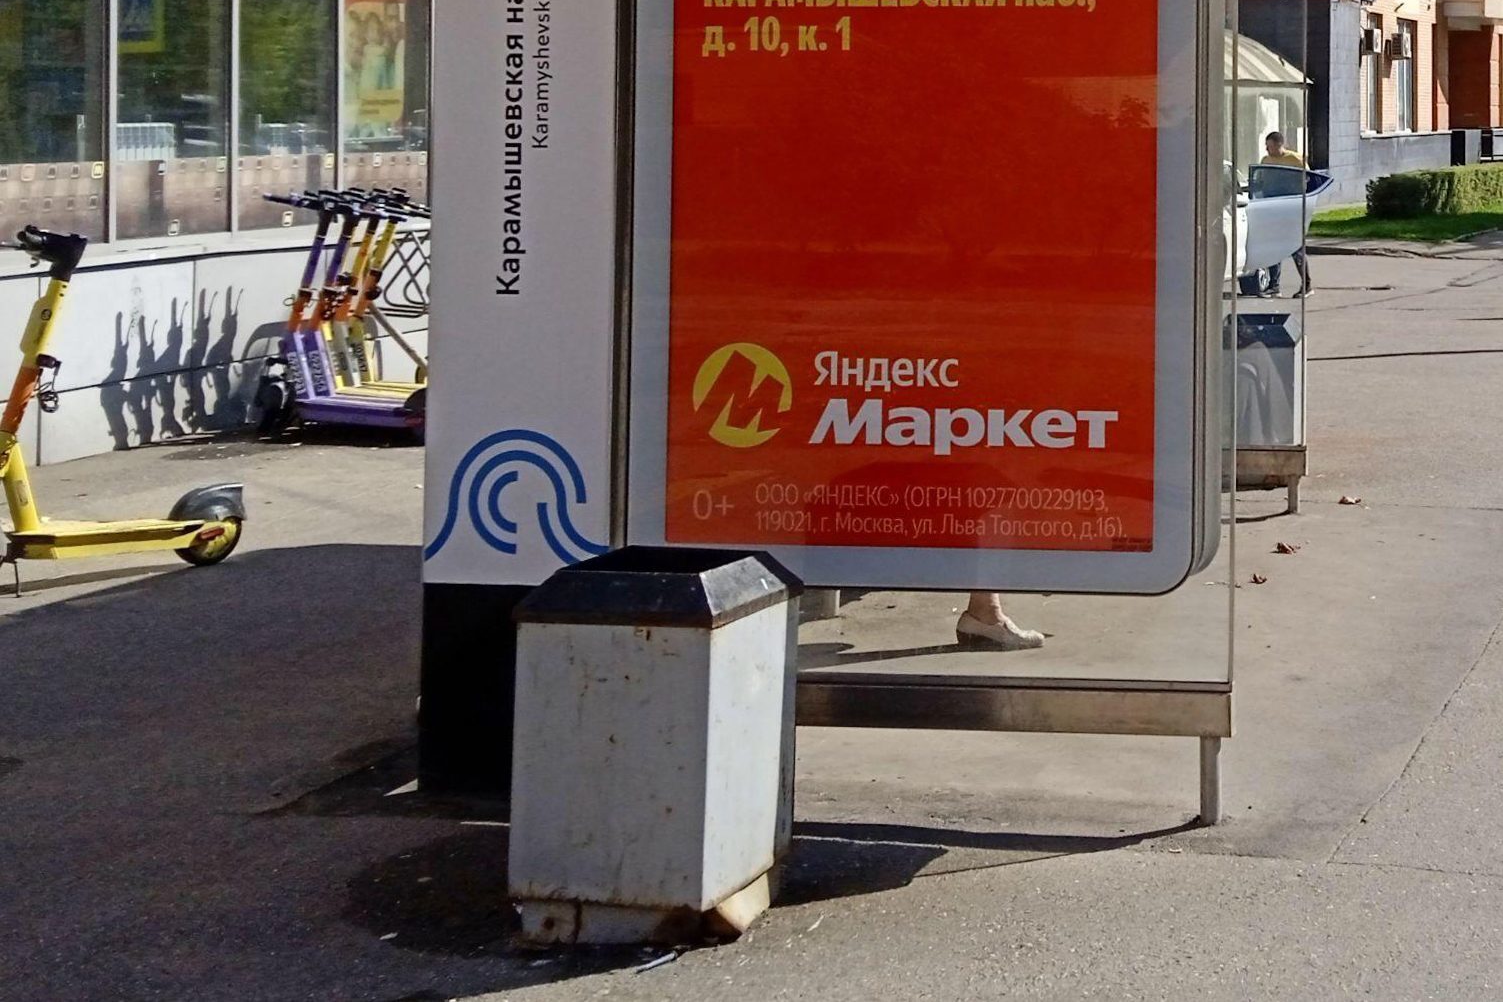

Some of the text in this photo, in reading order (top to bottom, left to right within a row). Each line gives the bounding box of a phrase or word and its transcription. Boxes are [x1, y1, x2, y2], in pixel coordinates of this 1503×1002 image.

[702, 16, 851, 57] д. 10, к. 1
[496, 34, 526, 295] Карамышевская
[813, 350, 960, 392] Яндекс
[808, 398, 1119, 456] Маркет
[692, 489, 735, 521] 0+
[755, 482, 799, 505] ООО
[803, 484, 899, 509] «ЯНДЕКС»
[904, 485, 961, 510] (ОГРН
[755, 509, 817, 534] 119021,
[820, 517, 831, 533] г.
[835, 514, 908, 536] Москва,
[912, 517, 937, 539] ул.
[941, 513, 986, 536] Льва
[990, 514, 1076, 539] Толстого,
